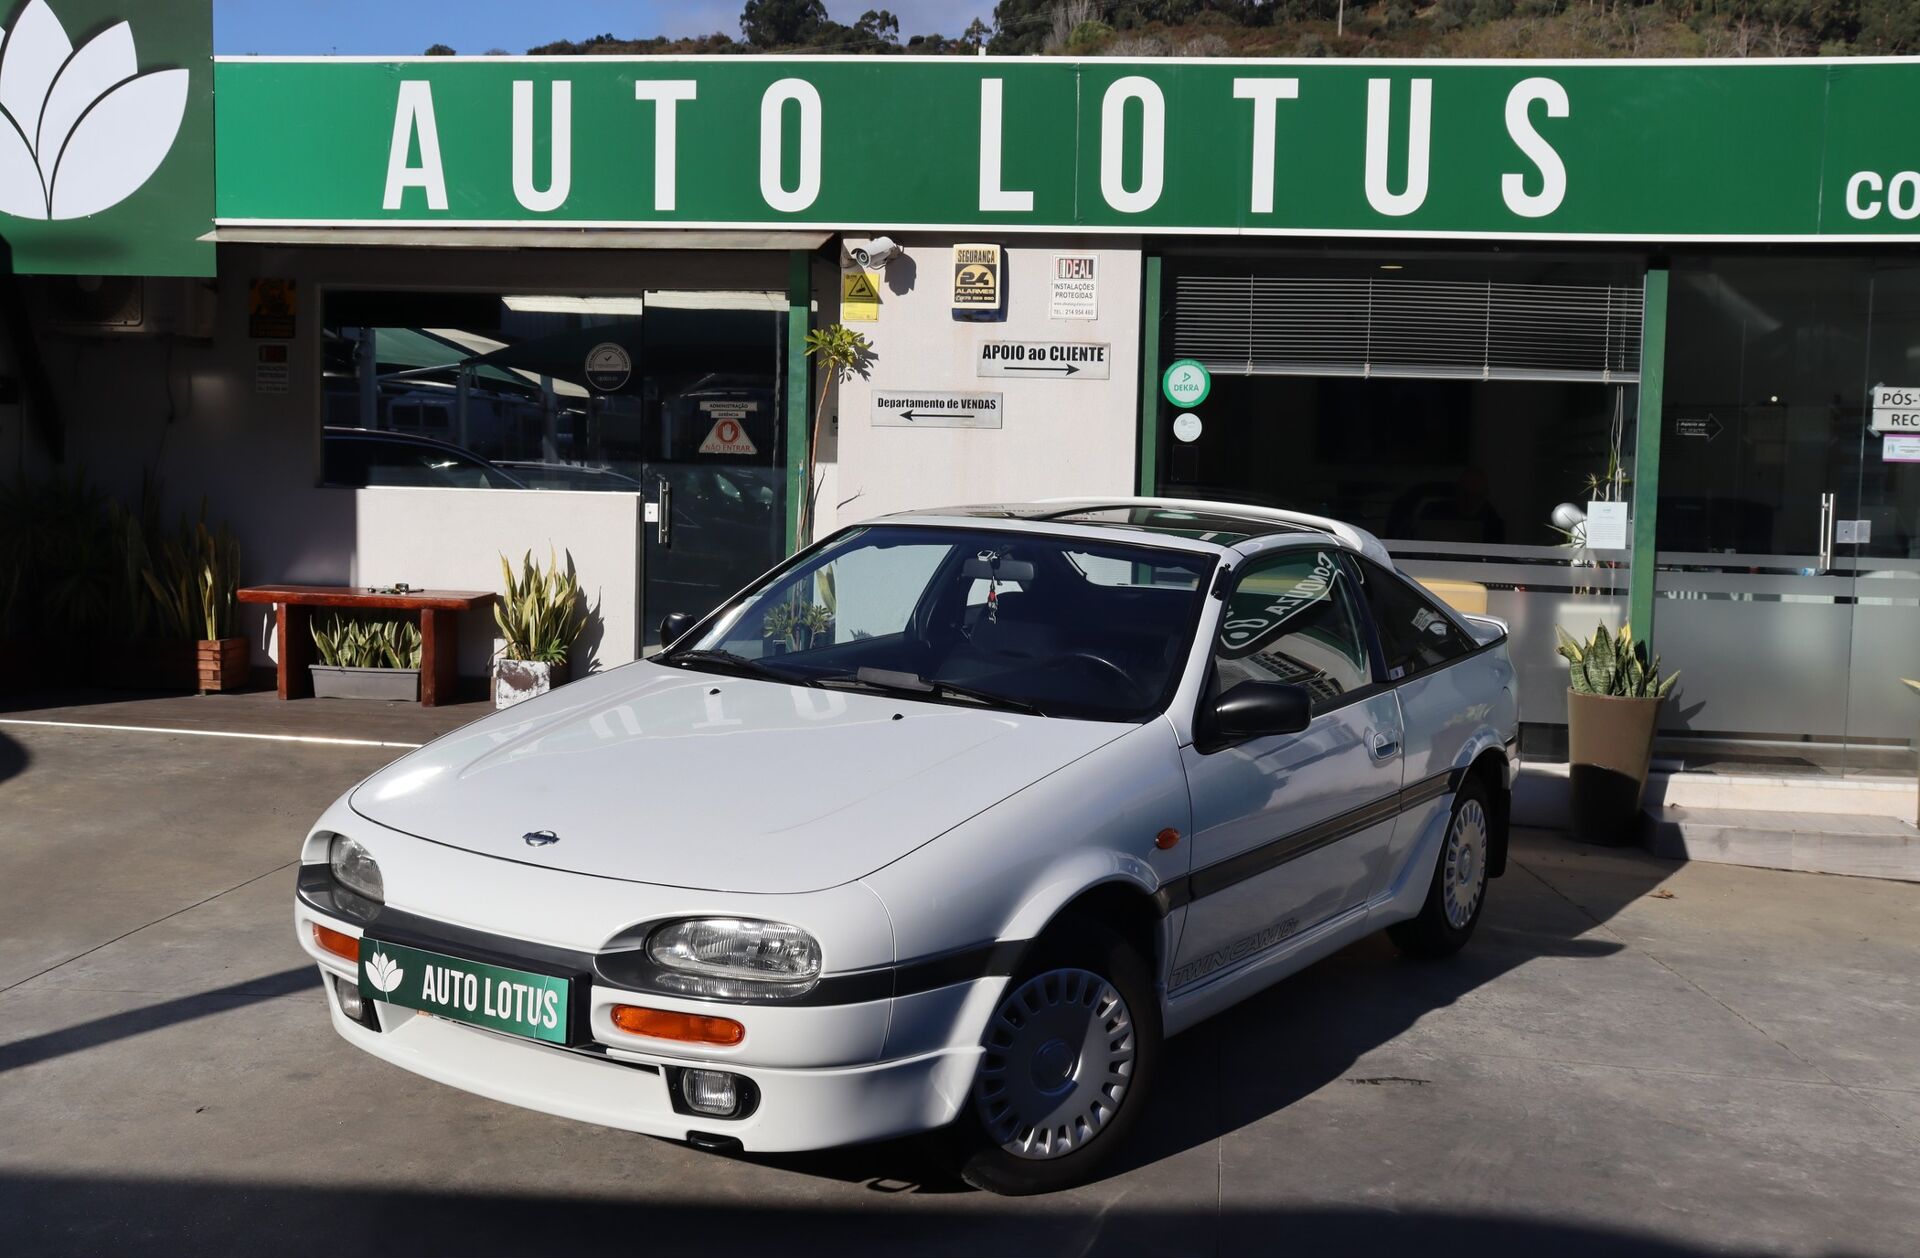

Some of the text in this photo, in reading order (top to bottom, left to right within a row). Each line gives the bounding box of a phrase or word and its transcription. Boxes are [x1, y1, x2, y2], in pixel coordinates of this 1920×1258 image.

[382, 76, 1570, 218] AUTO LOTUS
[1059, 258, 1092, 279] IDEAL
[960, 271, 989, 286] 24
[1053, 282, 1095, 291] INSTALAÇÕES
[1055, 291, 1093, 299] PROTEGIDAS
[982, 344, 1104, 362] APOIO ao CLIENTE
[1173, 384, 1199, 392] DEKRA
[877, 397, 997, 410] Departamento de VENDAS
[1882, 390, 1920, 405] PÓS-
[705, 443, 751, 452] NÃO ENTRAR
[421, 964, 558, 1029] AUTO LOTUS
